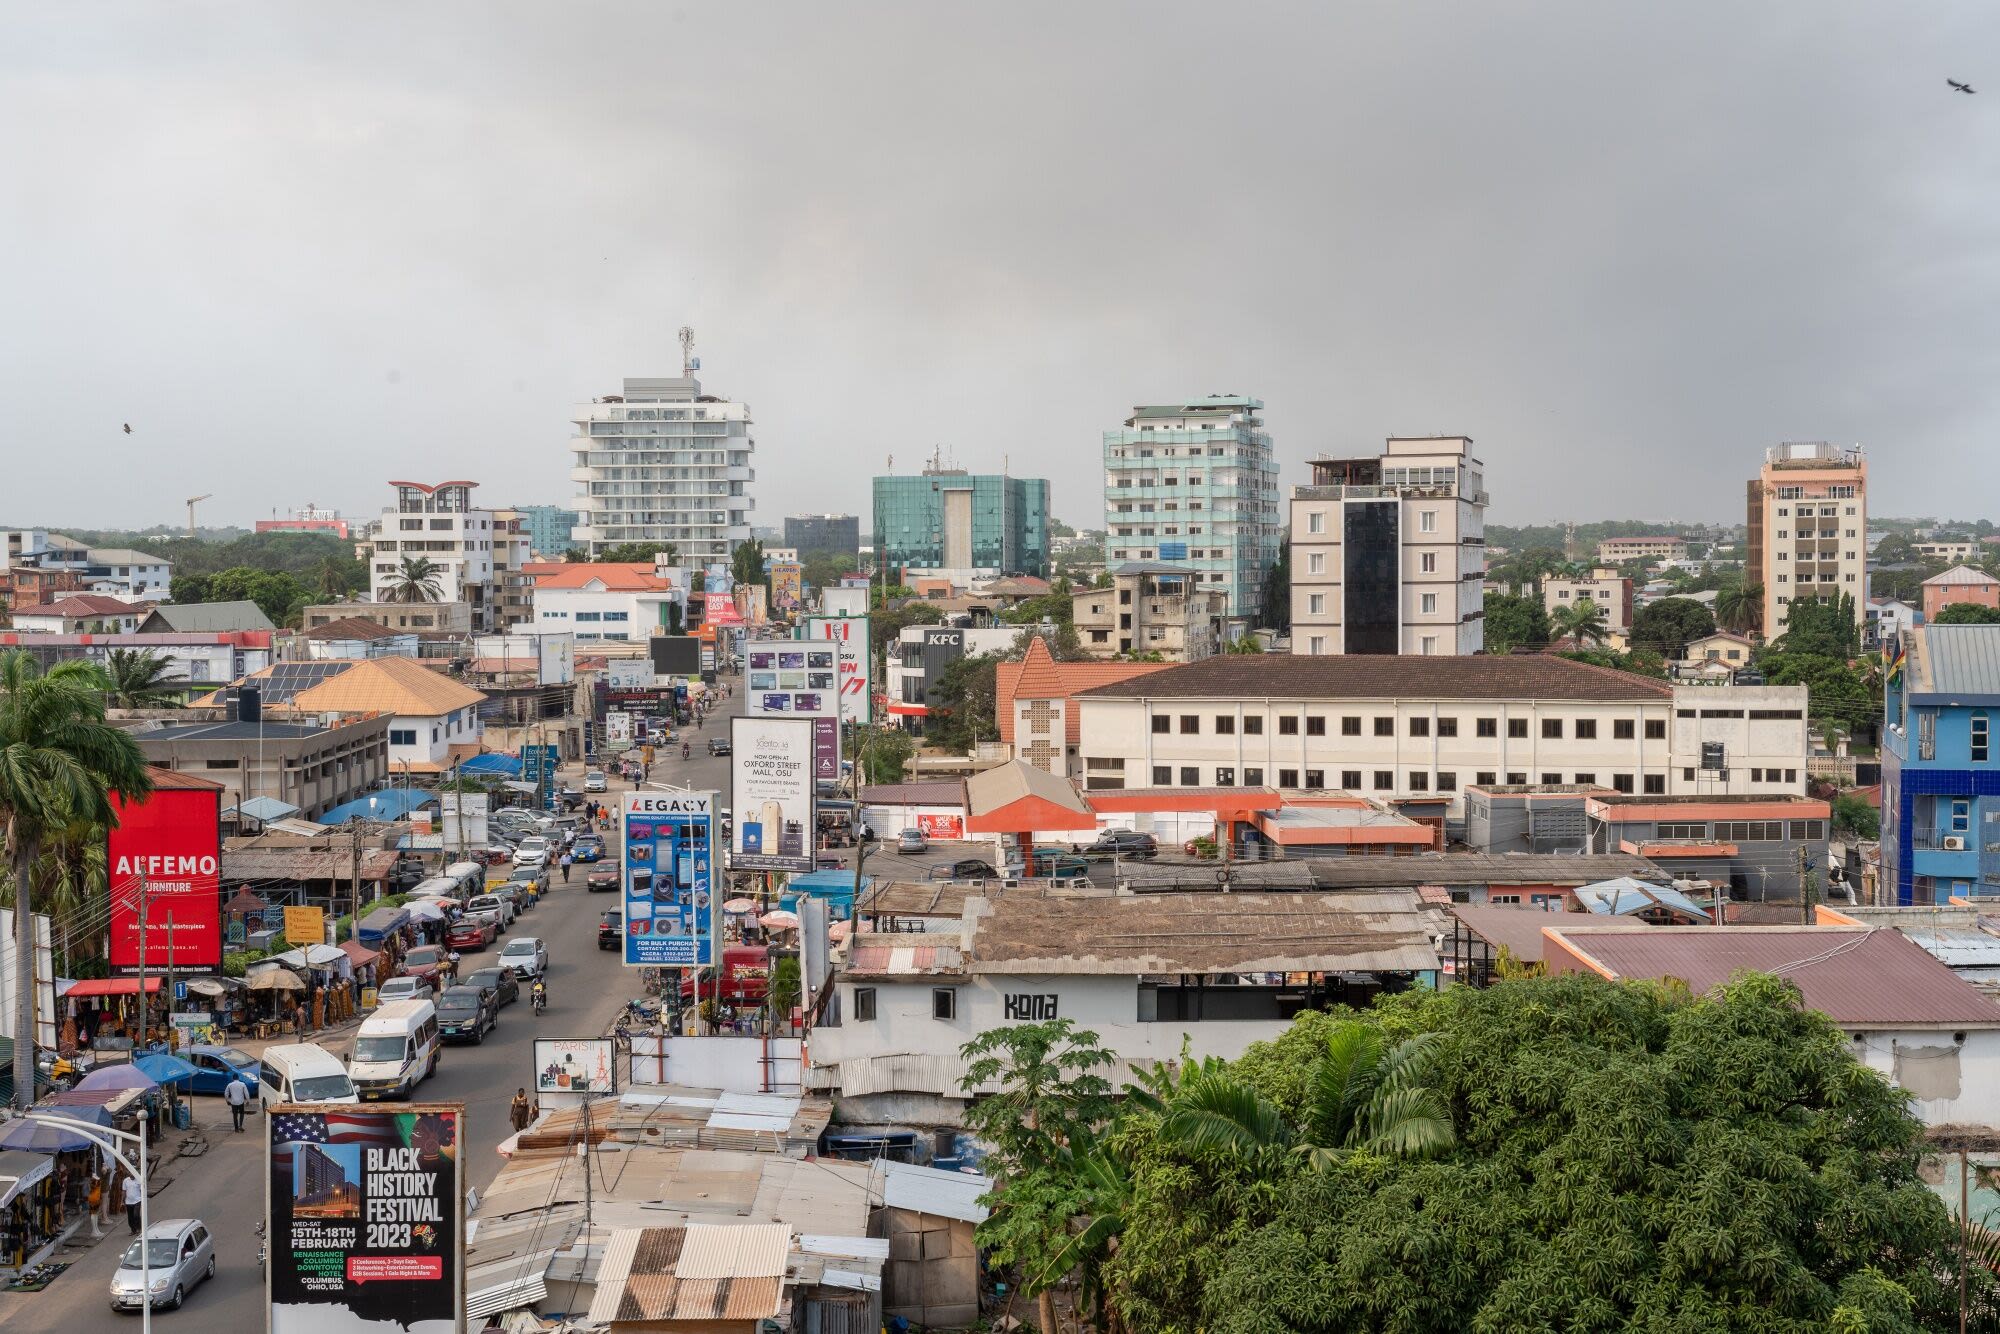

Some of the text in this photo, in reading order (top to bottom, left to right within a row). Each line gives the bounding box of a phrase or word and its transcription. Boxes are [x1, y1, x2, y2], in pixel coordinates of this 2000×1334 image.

[928, 634, 959, 645] KFC
[752, 769, 774, 777] MALL,
[632, 799, 707, 811] LEGACY
[116, 856, 217, 875] ALFEMO
[145, 882, 192, 892] URNITURE
[367, 1148, 421, 1171] BLACK
[367, 1173, 437, 1197] HISTORY
[367, 1198, 443, 1222] FESTIVAL
[291, 1227, 356, 1238] 15TH-18TH
[366, 1224, 410, 1248] 2023
[291, 1238, 356, 1248] FEBRUARY
[301, 1277, 344, 1285] COLUMBUS,
